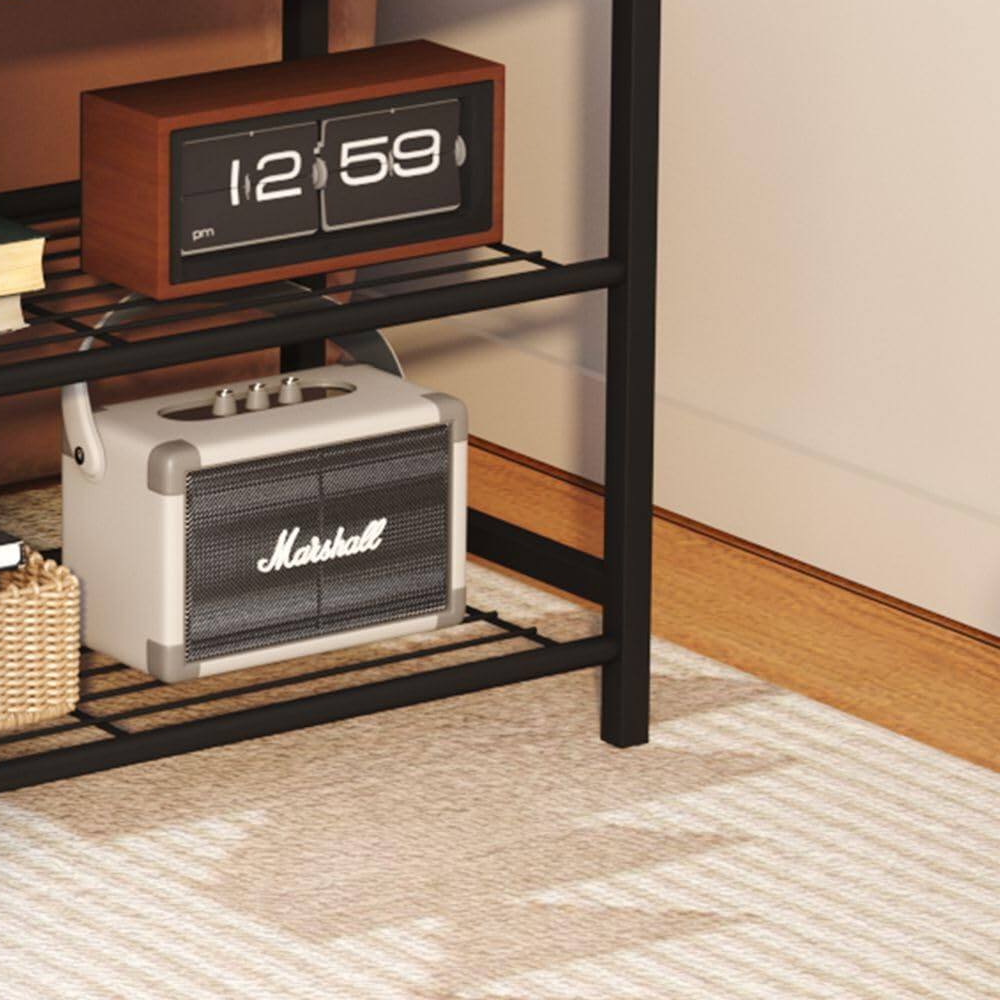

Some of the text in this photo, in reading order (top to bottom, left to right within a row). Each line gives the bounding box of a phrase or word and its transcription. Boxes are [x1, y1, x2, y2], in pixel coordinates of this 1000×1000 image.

[230, 128, 441, 206] 12 59
[191, 226, 215, 241] pm
[257, 517, 387, 573] Marshall
